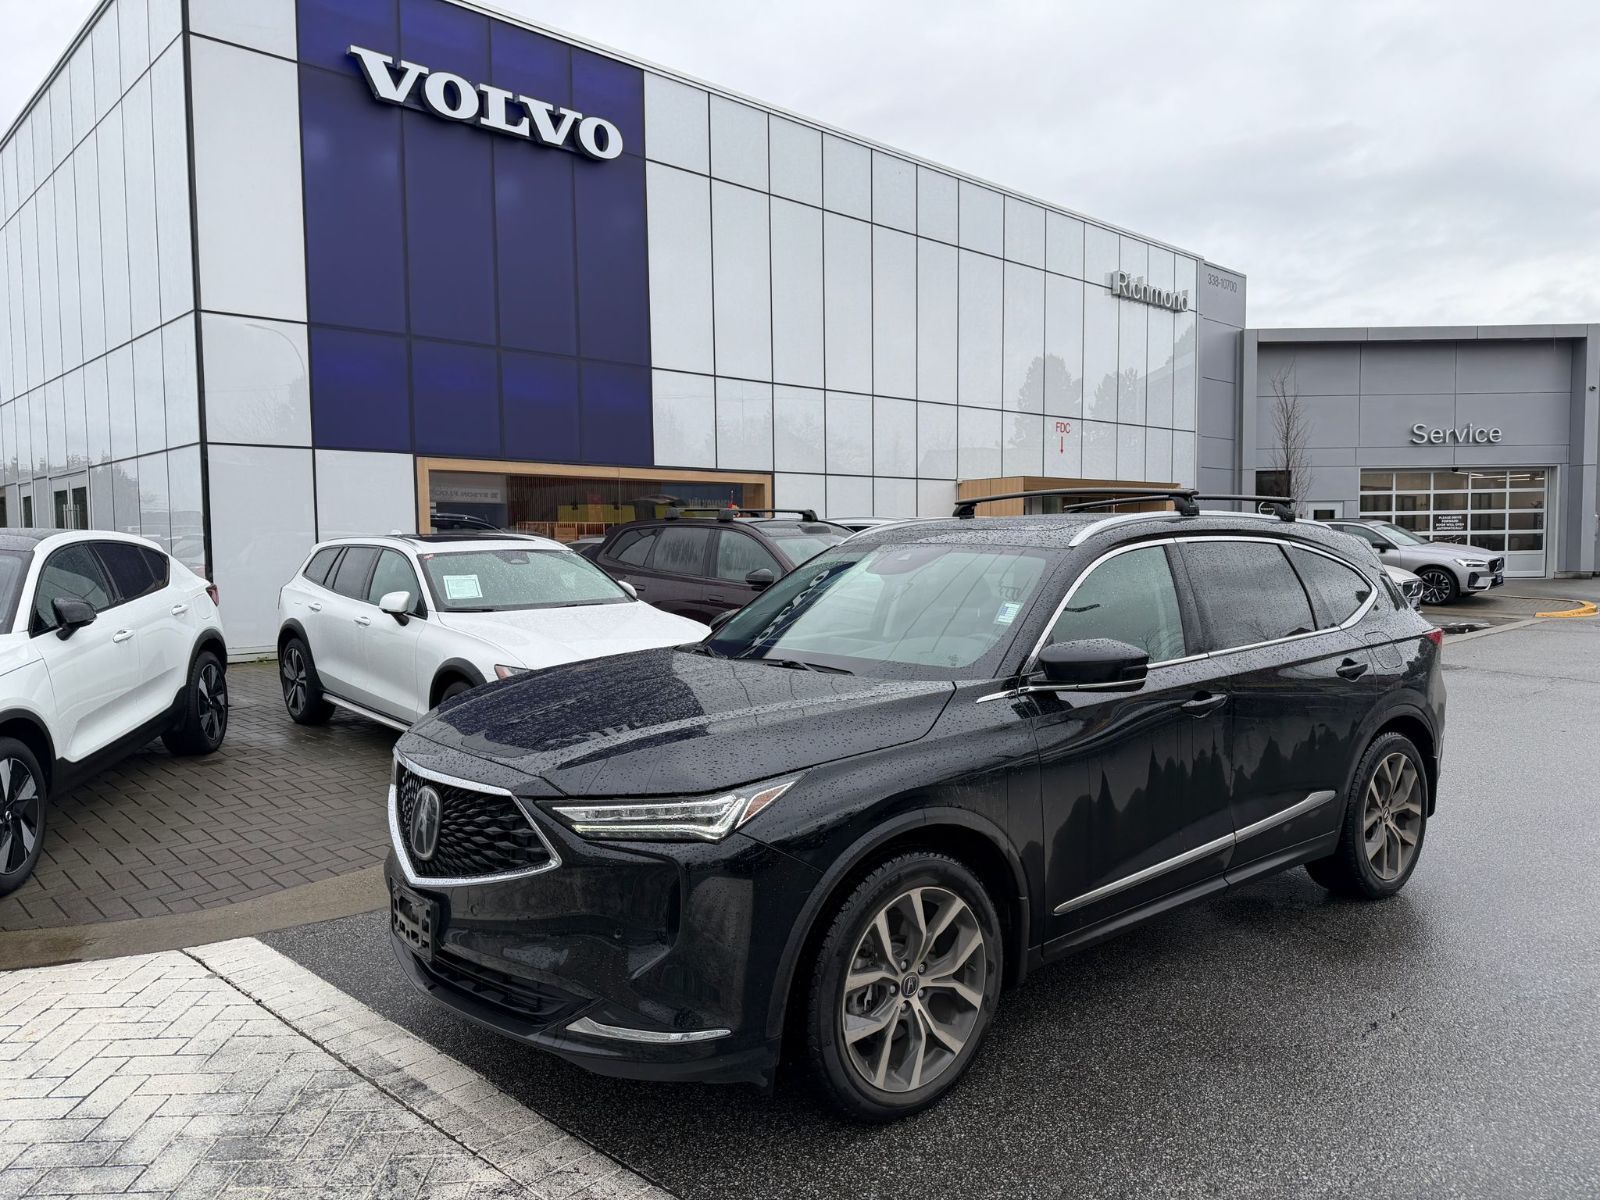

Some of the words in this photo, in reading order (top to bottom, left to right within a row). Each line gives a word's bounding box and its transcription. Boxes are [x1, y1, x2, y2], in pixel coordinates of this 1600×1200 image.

[348, 44, 624, 162] VOLVO
[1114, 270, 1188, 312] Richmond
[1055, 421, 1071, 434] FDC
[1411, 422, 1502, 444] Service
